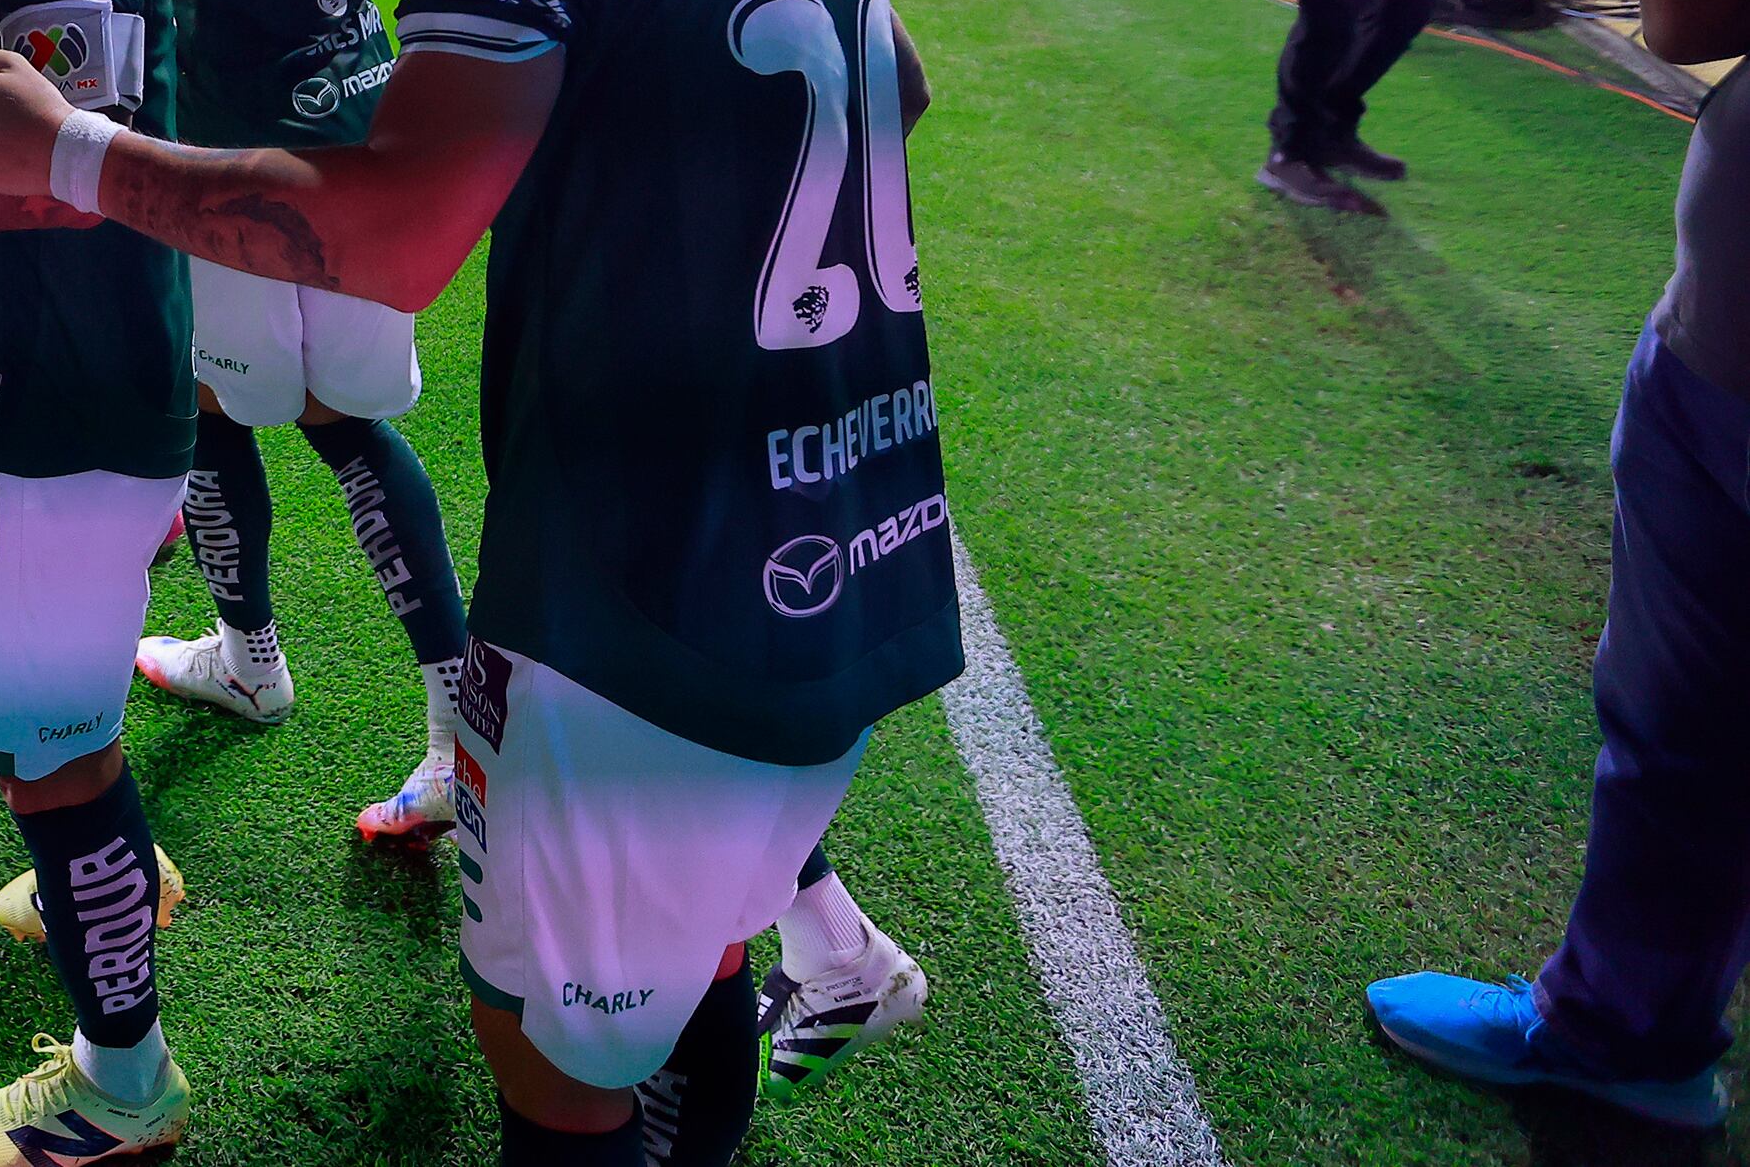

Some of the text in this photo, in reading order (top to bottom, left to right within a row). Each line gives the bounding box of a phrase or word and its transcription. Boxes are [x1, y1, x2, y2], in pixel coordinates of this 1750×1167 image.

[76, 77, 98, 90] MX
[342, 59, 397, 98] mazd
[850, 494, 948, 576] mazd
[38, 711, 105, 746] CHARLY
[562, 981, 655, 1016] CHARLY
